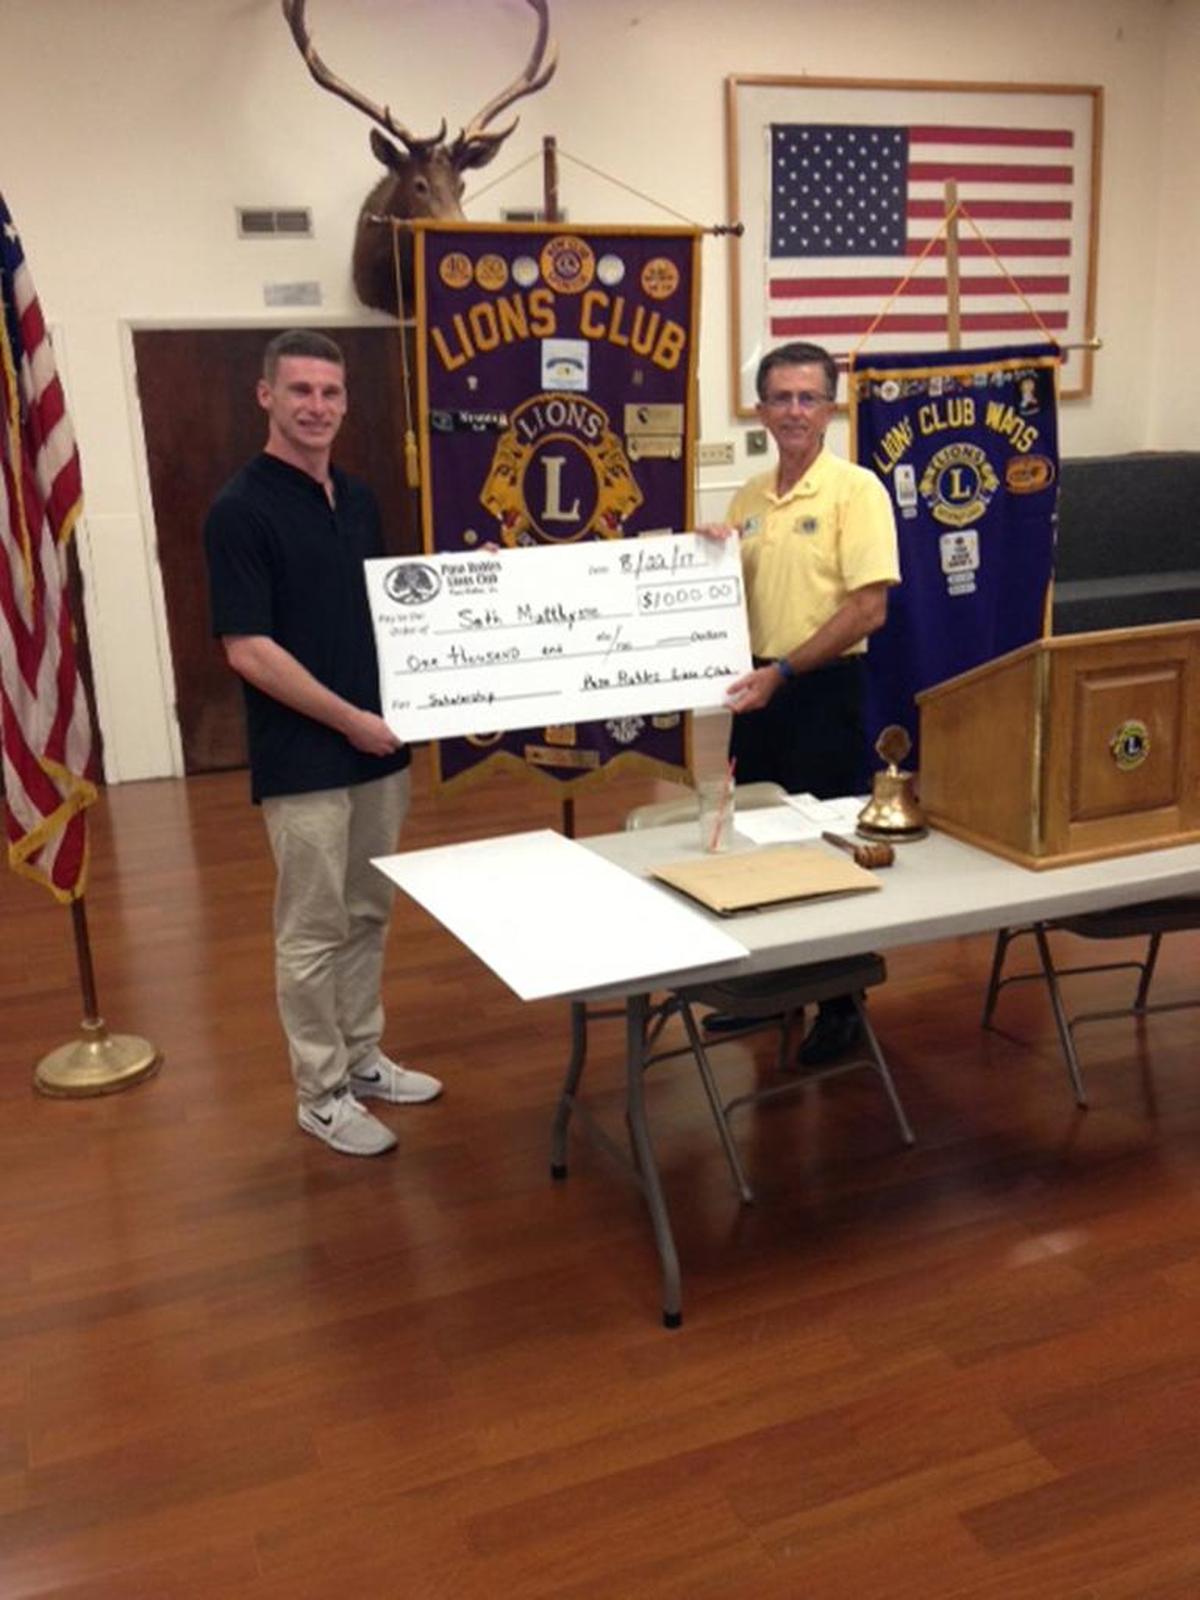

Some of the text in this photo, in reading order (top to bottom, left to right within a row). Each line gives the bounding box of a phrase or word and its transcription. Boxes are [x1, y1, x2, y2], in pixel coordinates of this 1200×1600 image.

[432, 288, 686, 371] LIONS CLUB
[518, 401, 602, 440] LIONS
[919, 397, 976, 436] CLUB
[541, 456, 581, 521] L
[949, 468, 971, 499] L
[405, 654, 439, 672] One
